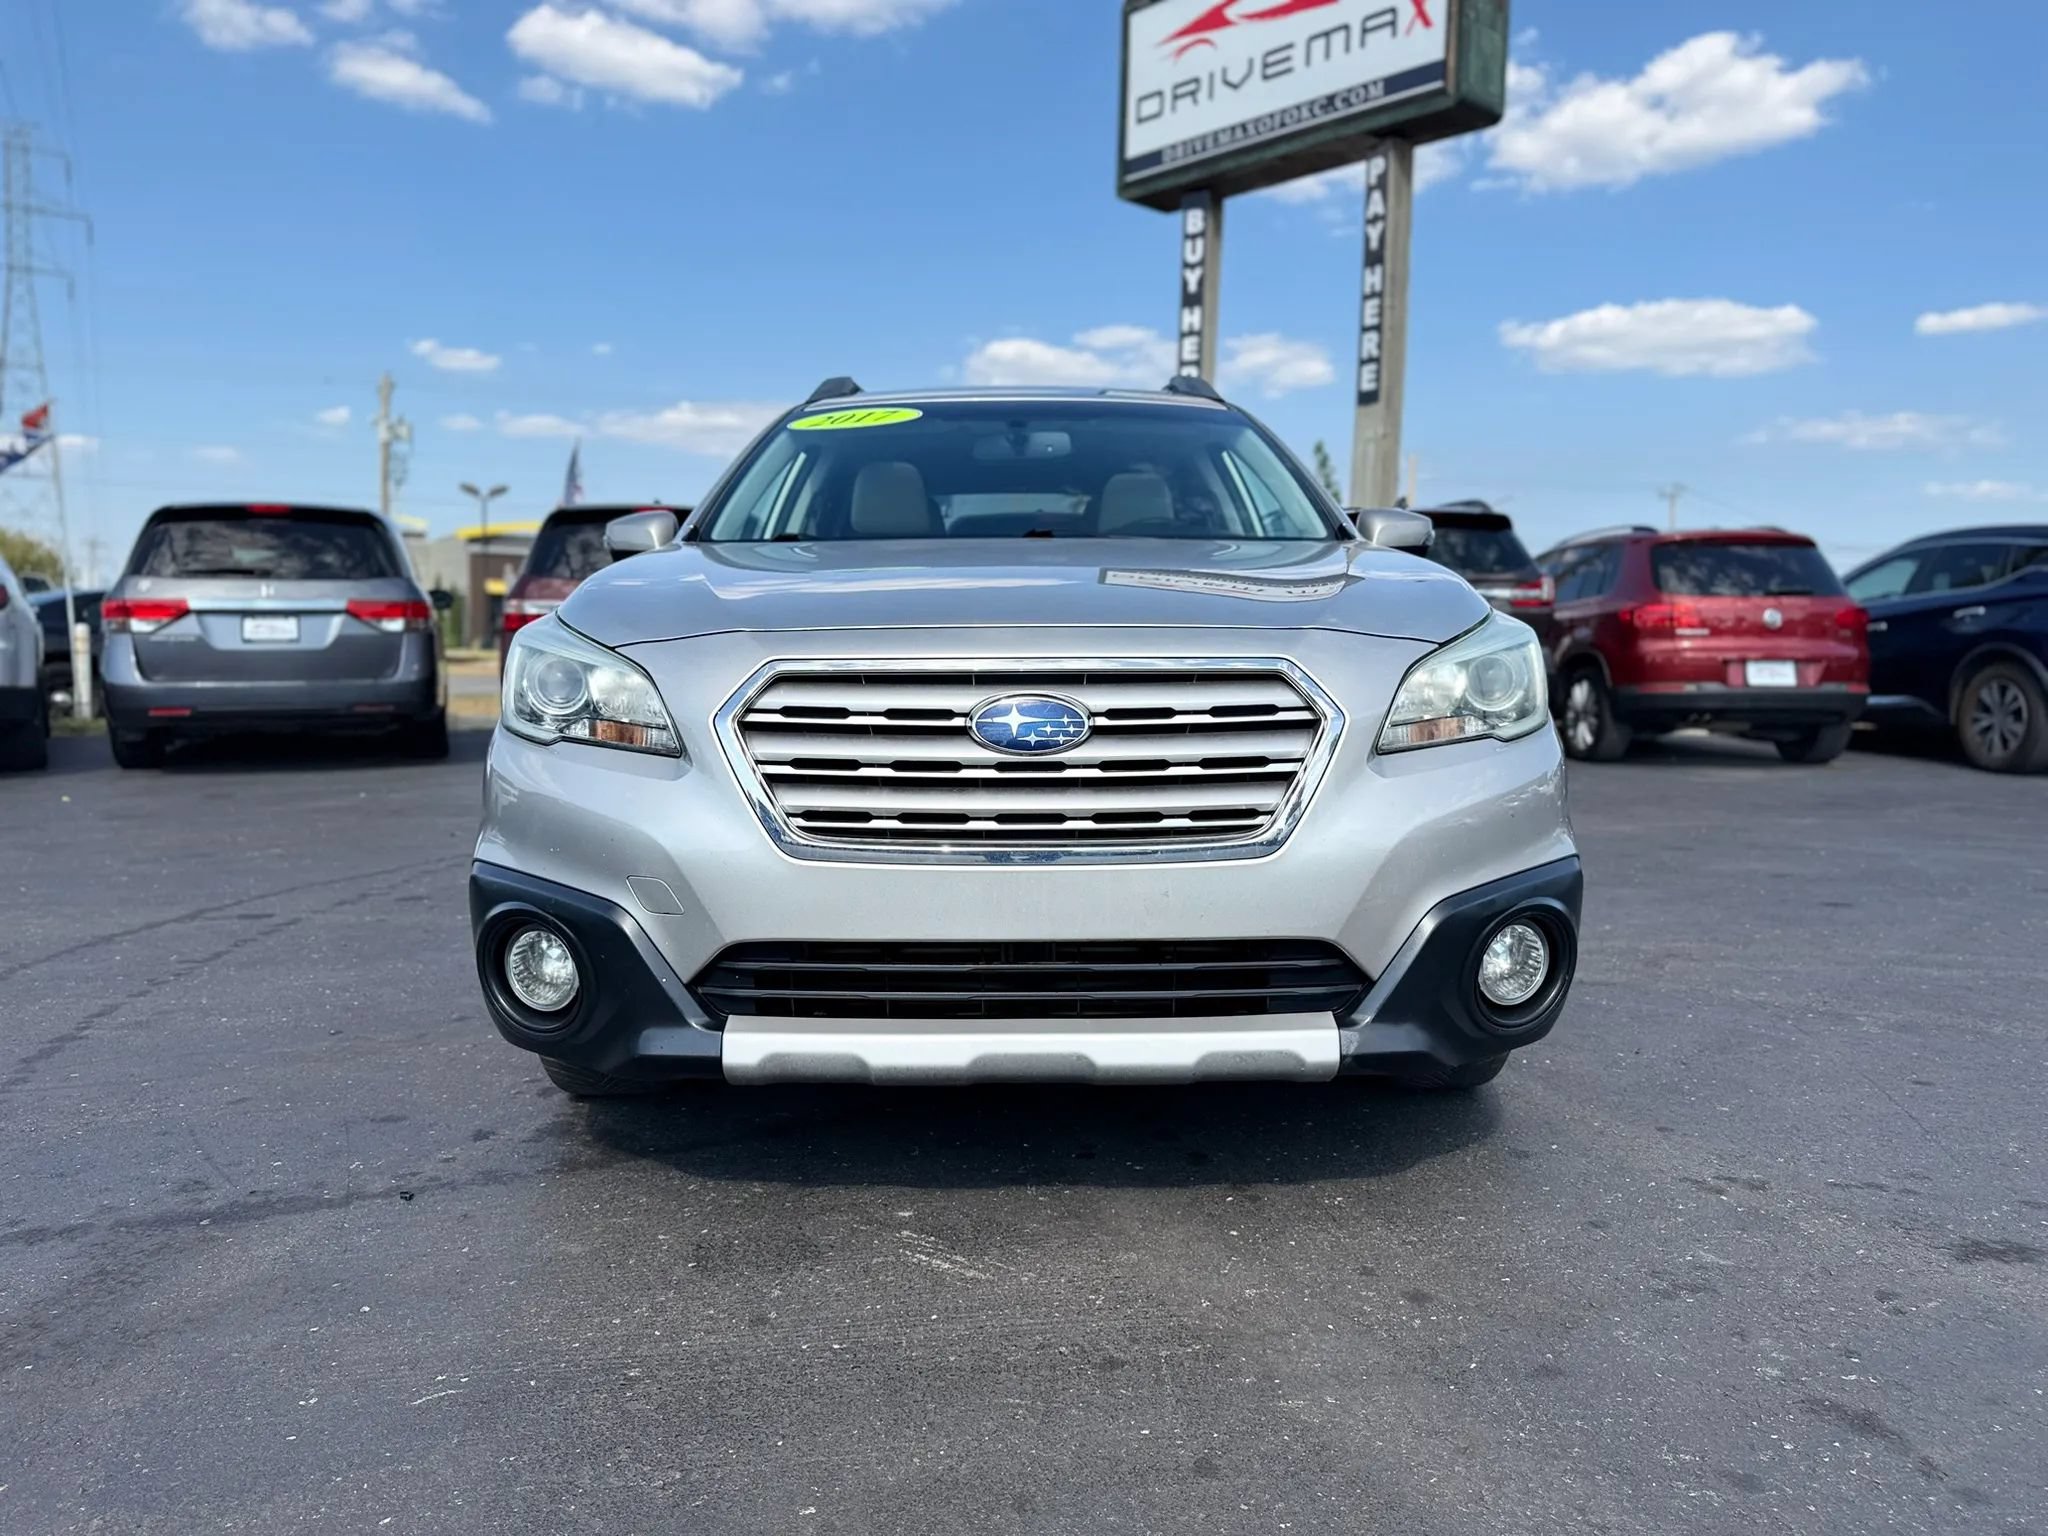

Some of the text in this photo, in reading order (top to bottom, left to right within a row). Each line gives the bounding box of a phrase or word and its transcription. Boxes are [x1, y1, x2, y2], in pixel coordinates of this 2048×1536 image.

[1184, 208, 1204, 294] BUY
[1360, 155, 1386, 392] PAY HERE
[806, 410, 899, 428] 2017
